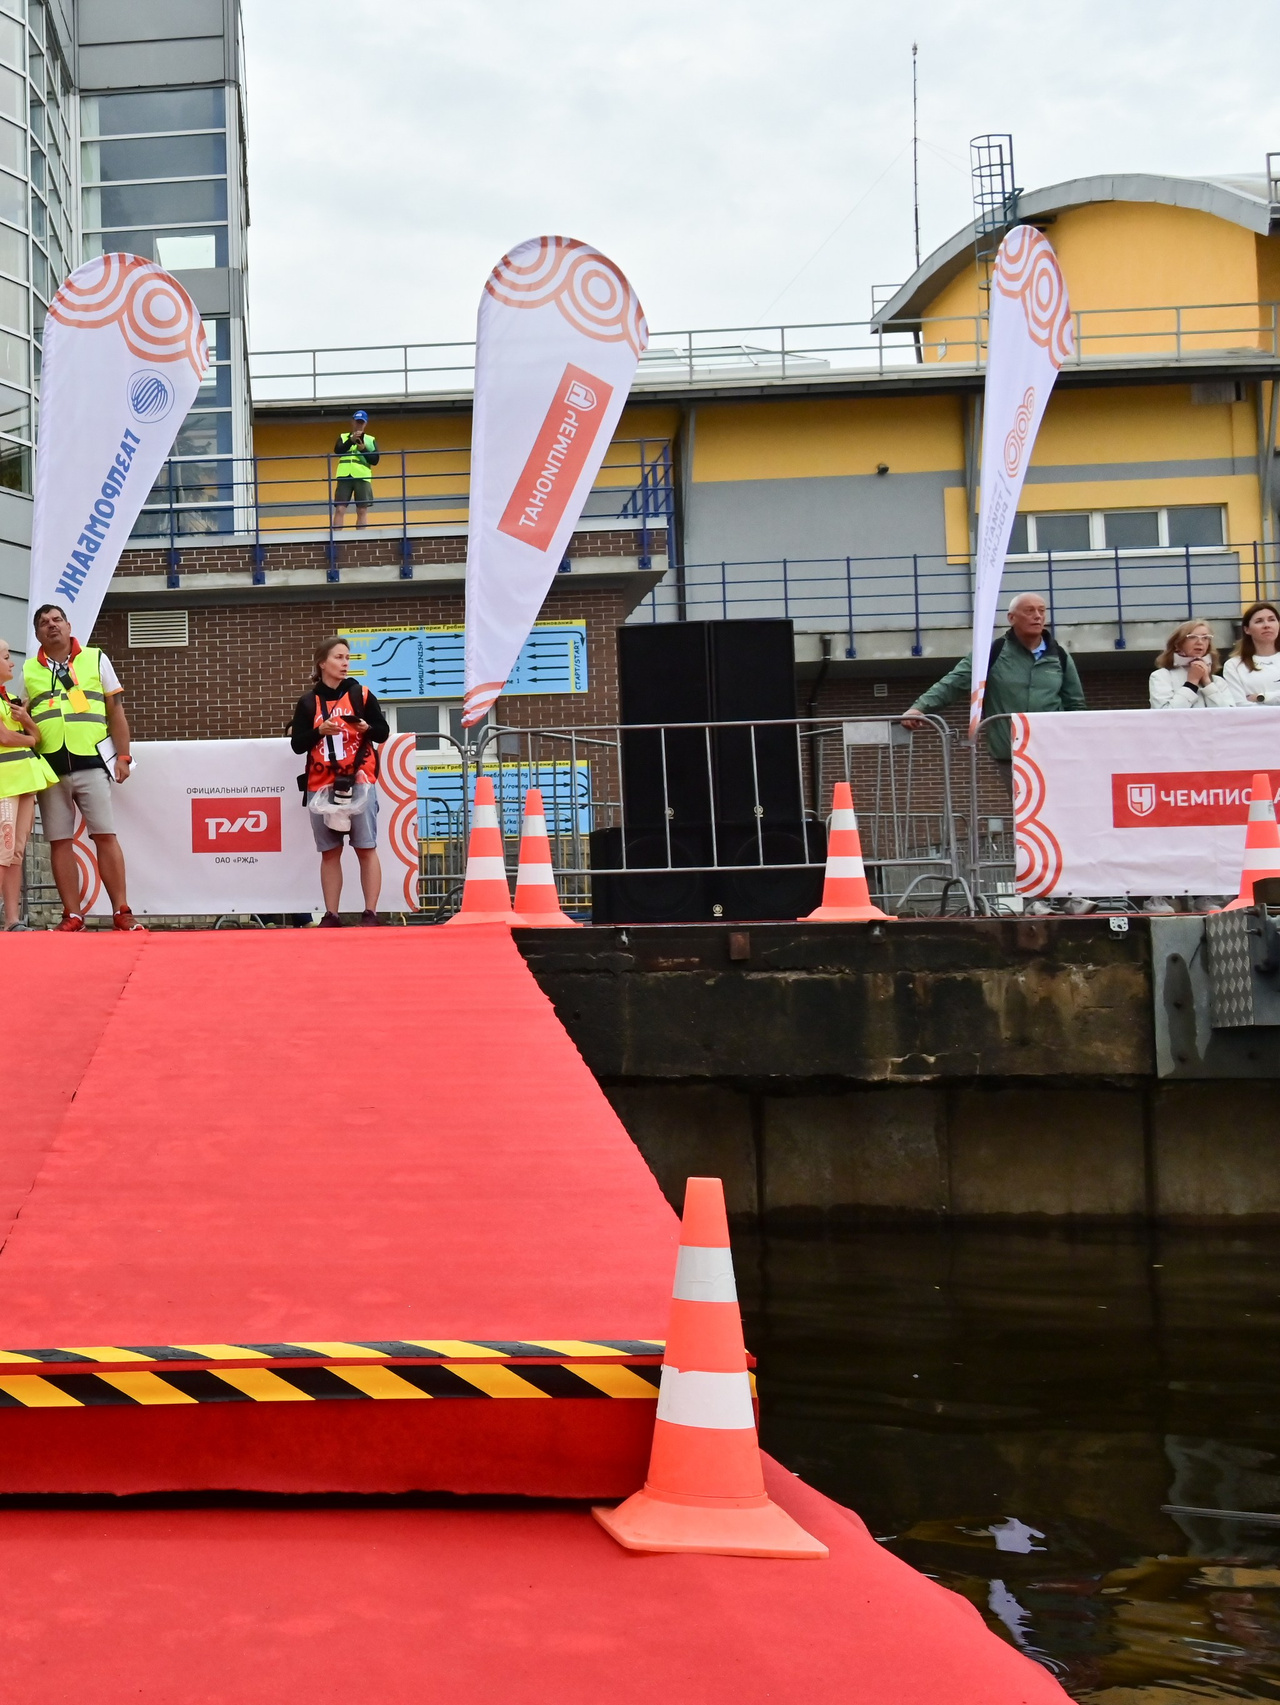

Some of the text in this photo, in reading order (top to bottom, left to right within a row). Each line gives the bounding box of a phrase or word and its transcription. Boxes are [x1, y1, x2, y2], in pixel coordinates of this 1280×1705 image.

[573, 640, 582, 691] СТАРТ/START
[186, 786, 249, 795] ОФИЦИАЛЬНЫЙ
[1160, 787, 1280, 806] ЧЕМПИО
